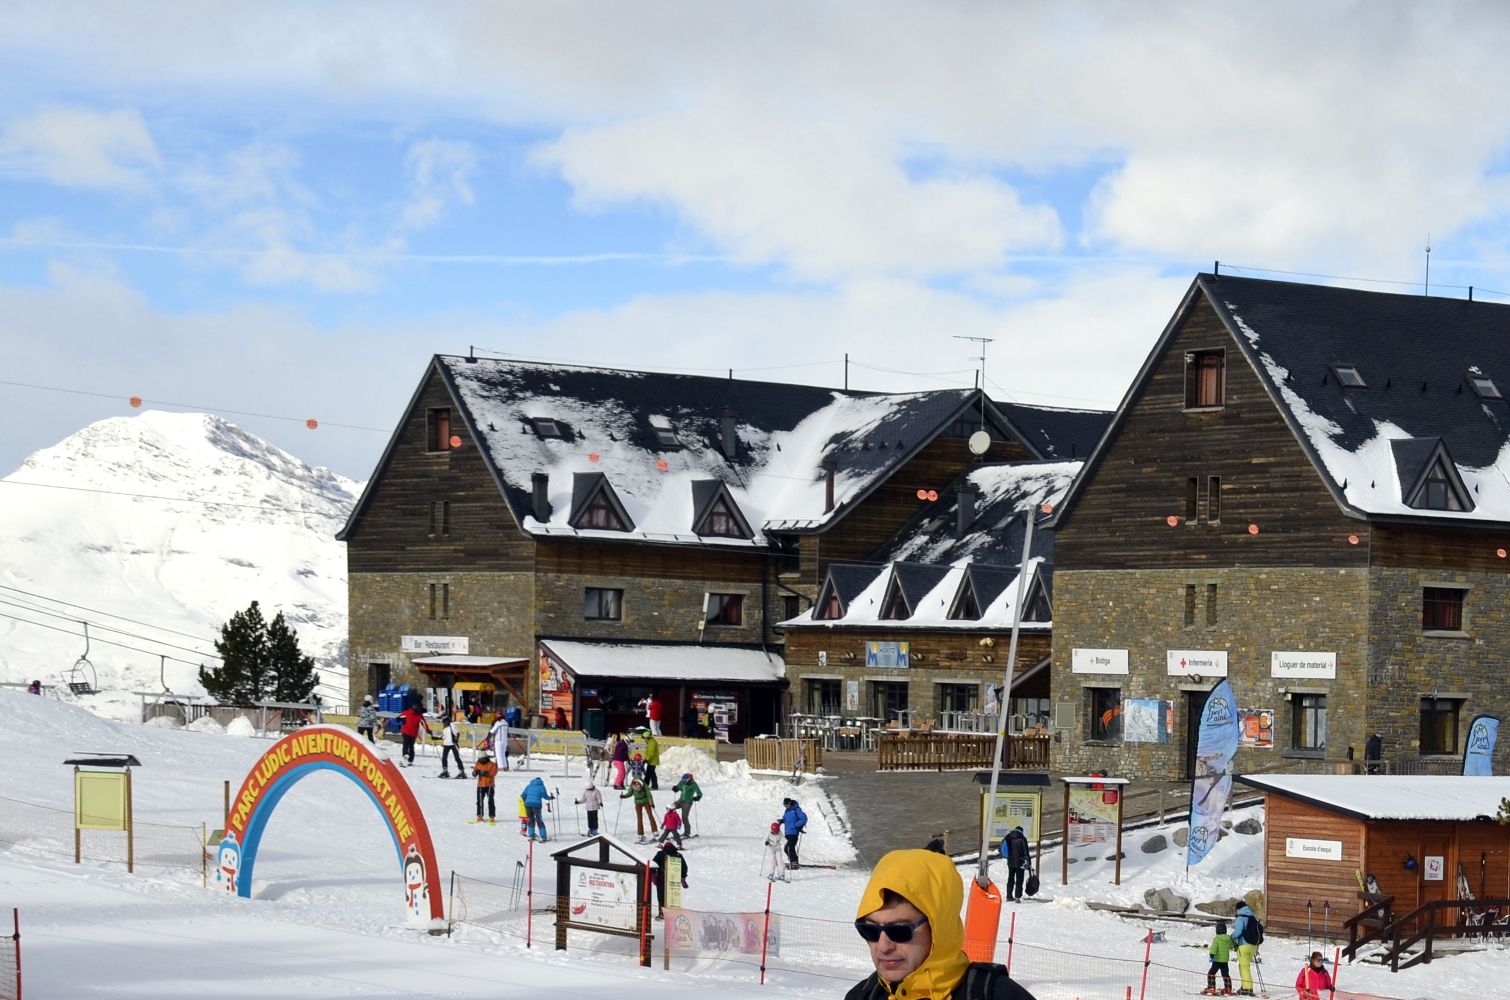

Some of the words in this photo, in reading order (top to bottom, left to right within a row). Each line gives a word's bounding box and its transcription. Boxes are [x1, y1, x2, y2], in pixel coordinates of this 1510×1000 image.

[1095, 656, 1111, 665] Botiga
[1188, 658, 1213, 667] Infermeria
[1279, 660, 1298, 670] Lloguer
[1299, 661, 1306, 669] de
[1306, 661, 1327, 669] material
[232, 779, 260, 831] PARC
[256, 744, 291, 787] LÚDIC
[292, 733, 358, 767] AVENTURA
[359, 753, 392, 799] PORT
[387, 796, 415, 843] AINÉ
[1302, 844, 1317, 852] Escola
[1317, 846, 1332, 854] d'esqui
